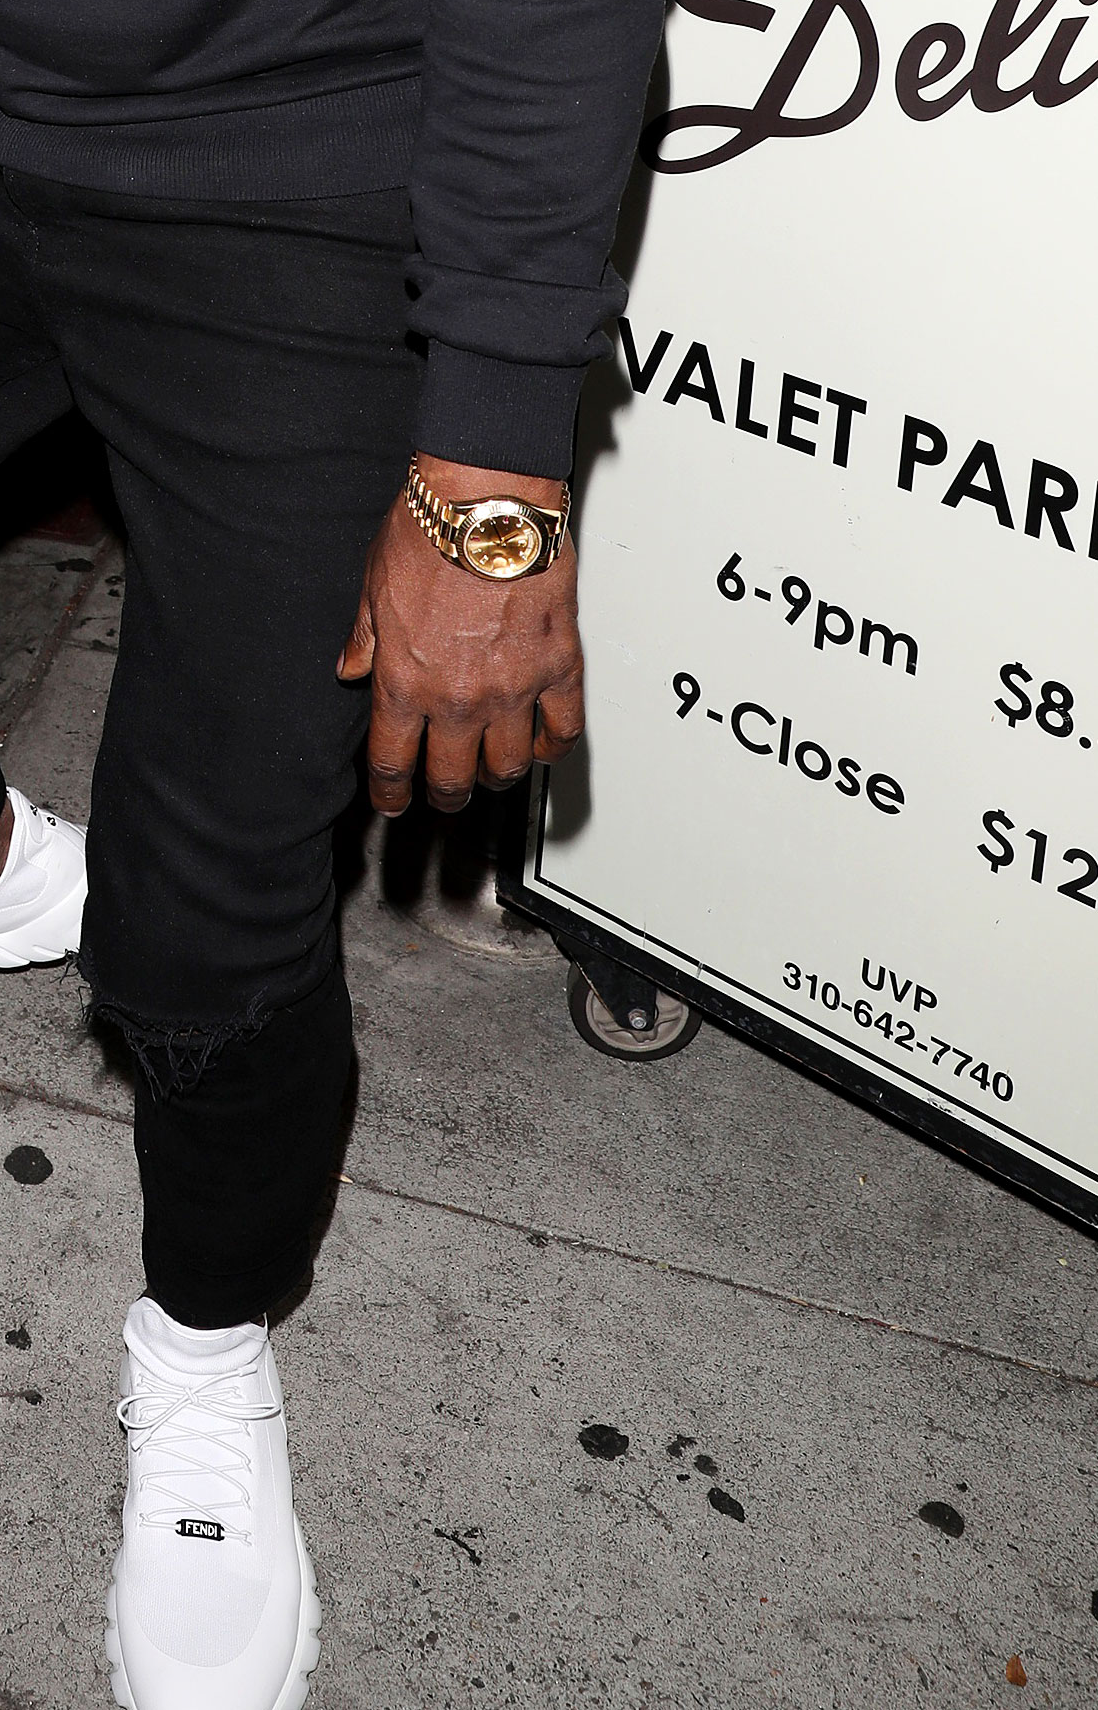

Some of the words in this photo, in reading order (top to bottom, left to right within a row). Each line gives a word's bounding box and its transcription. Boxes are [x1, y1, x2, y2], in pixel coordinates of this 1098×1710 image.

[617, 315, 868, 469] VALET
[897, 414, 1098, 560] PAR
[716, 551, 919, 676] 6-9pm
[672, 672, 906, 815] 9-Close
[976, 809, 1098, 909] $12
[782, 962, 1014, 1103] 310-642-7740
[861, 957, 938, 1014] UVP
[185, 1521, 217, 1537] FENDI
